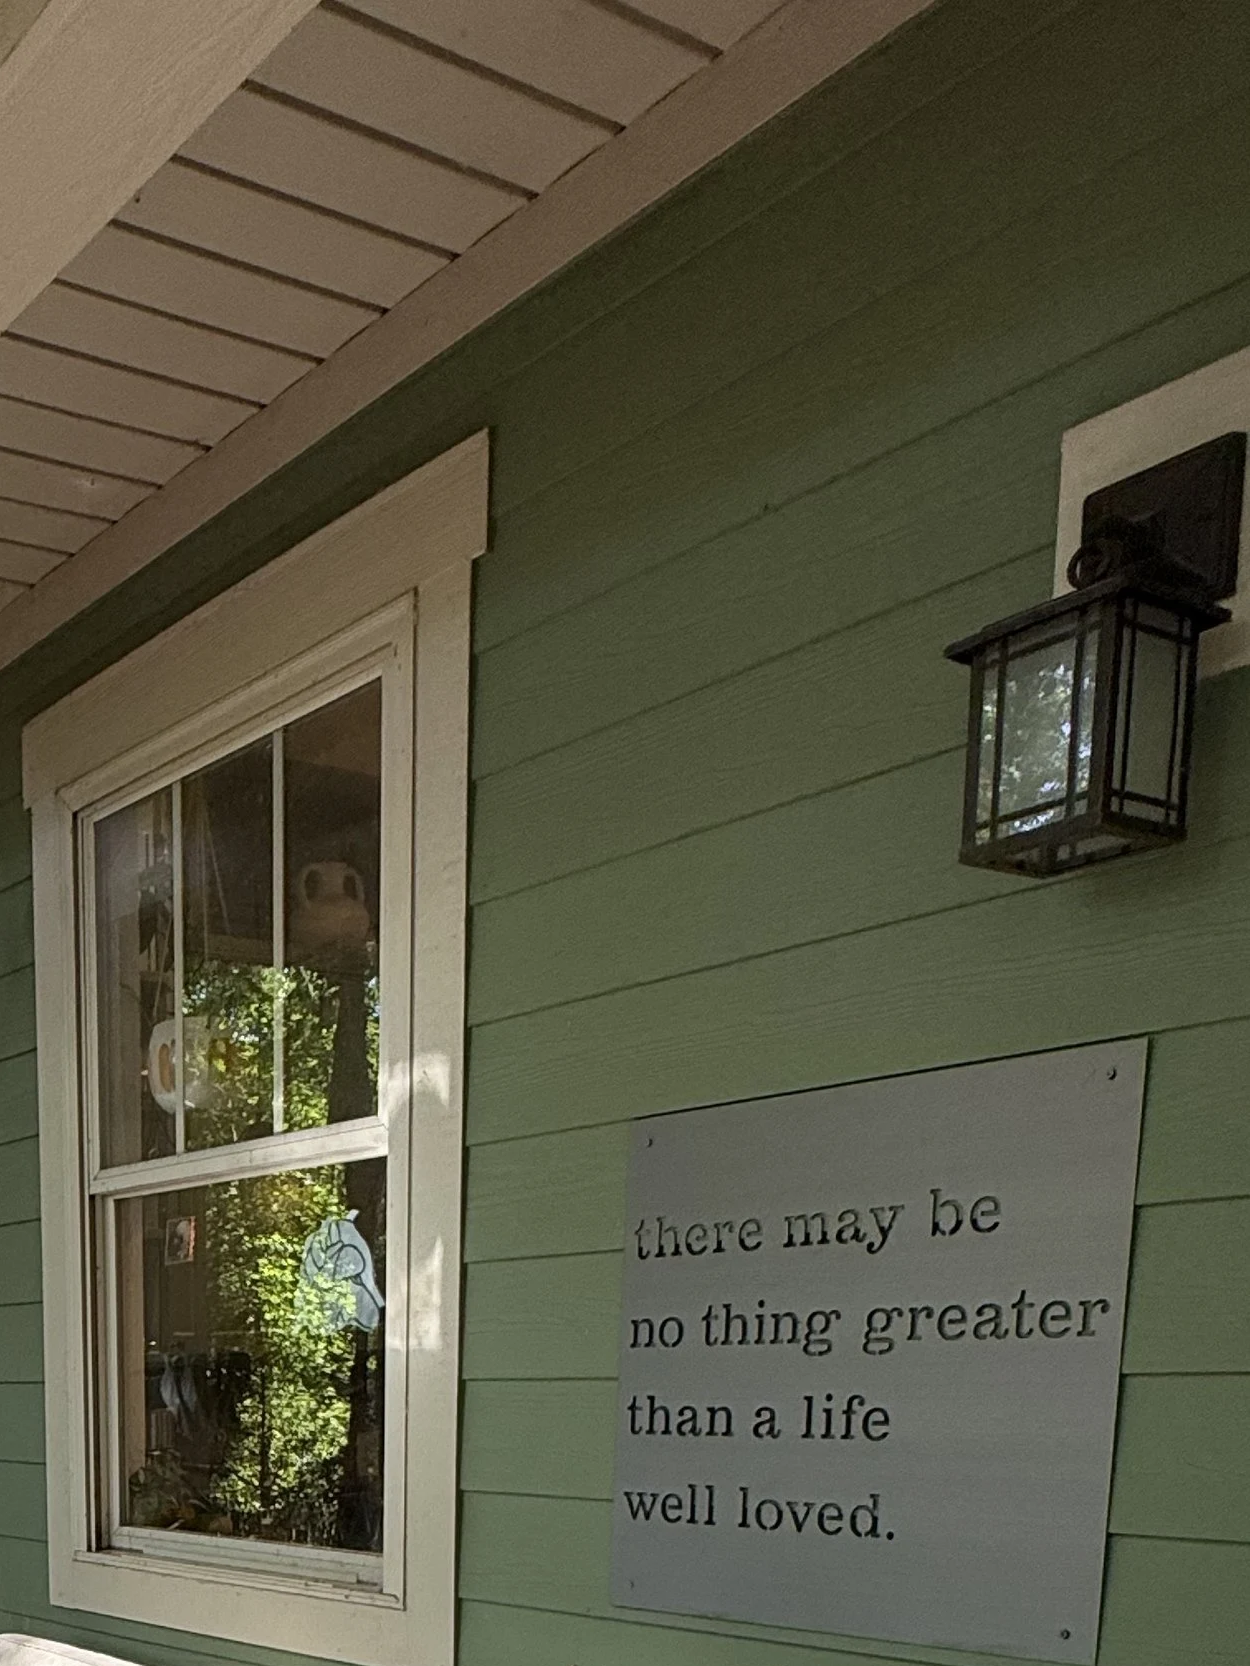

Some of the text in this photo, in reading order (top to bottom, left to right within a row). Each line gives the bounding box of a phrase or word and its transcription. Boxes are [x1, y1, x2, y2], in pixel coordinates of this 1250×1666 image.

[634, 1188, 1002, 1260] there may be
[630, 1289, 1111, 1357] no thing greater
[627, 1393, 891, 1442] than a life
[623, 1484, 895, 1540] well loved.
